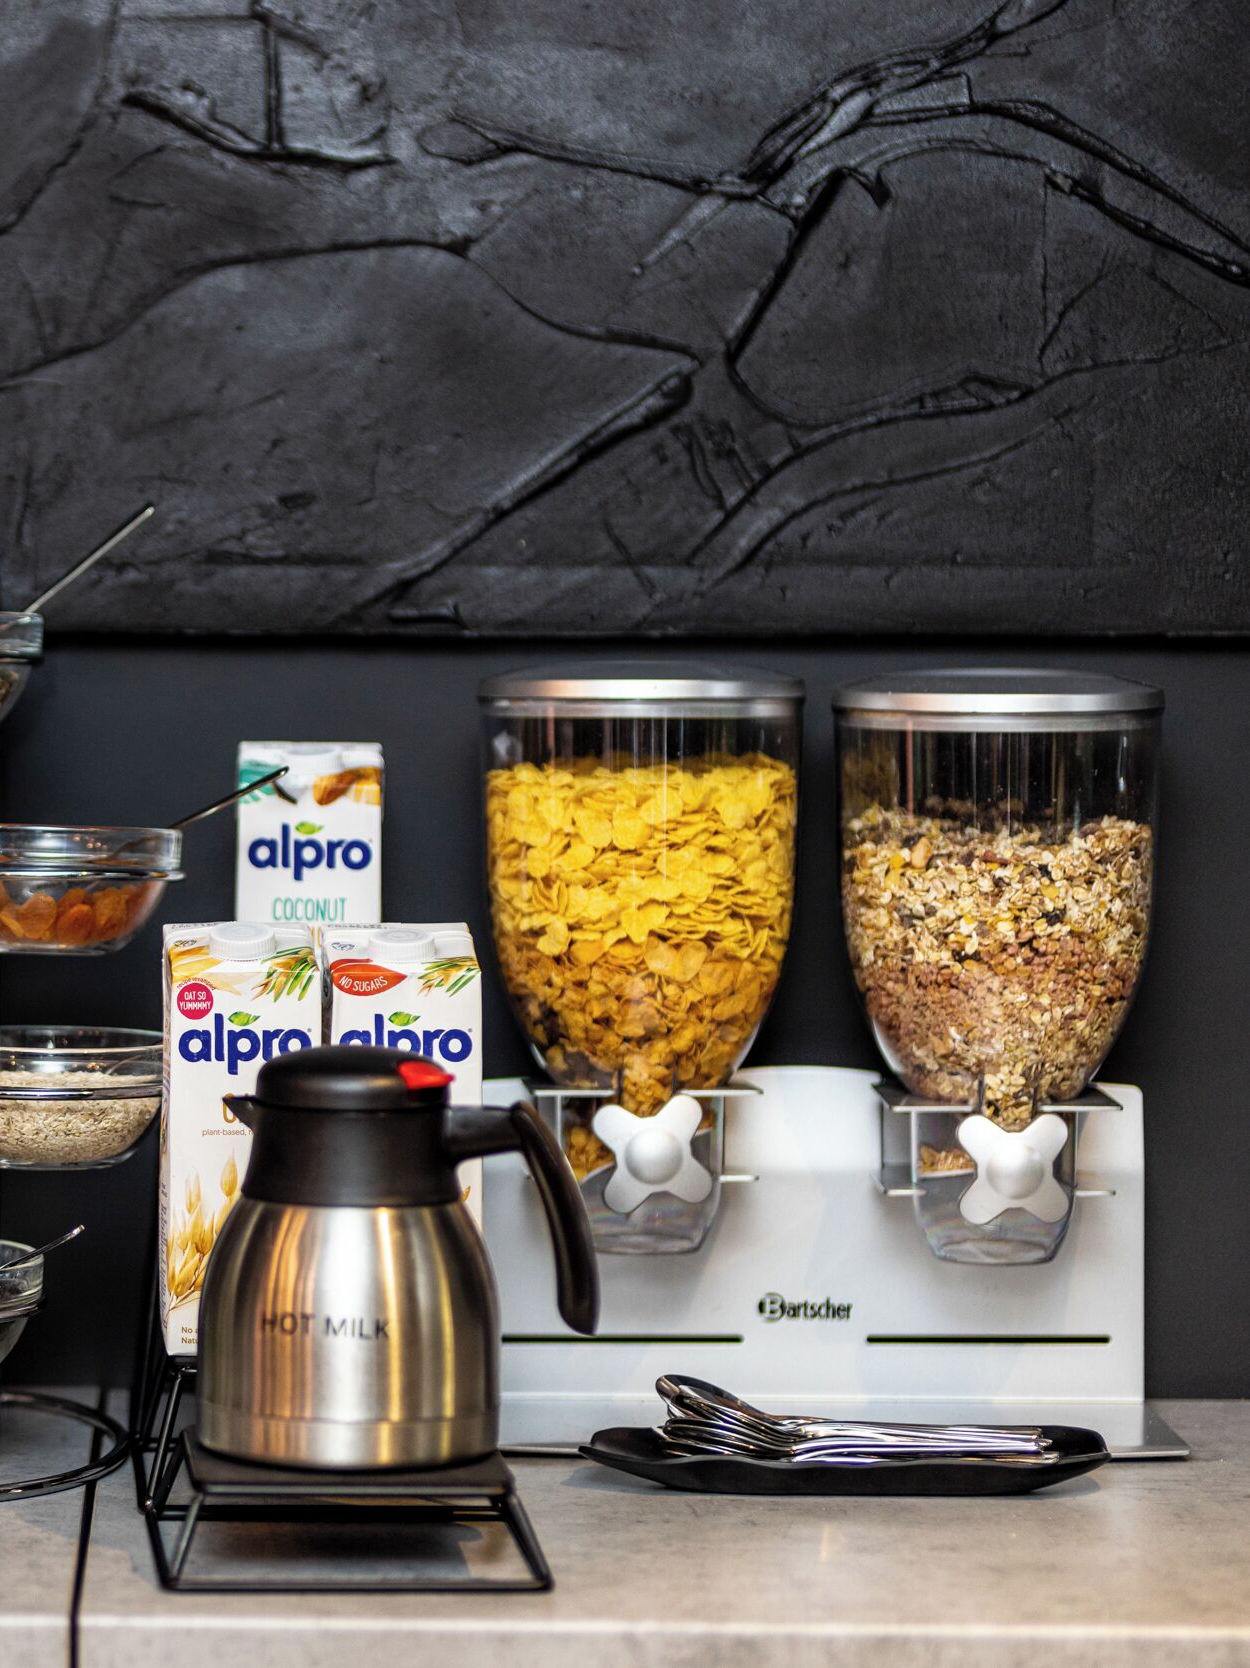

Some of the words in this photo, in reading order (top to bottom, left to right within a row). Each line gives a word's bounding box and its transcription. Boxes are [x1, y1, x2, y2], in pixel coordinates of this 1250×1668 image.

[249, 823, 372, 881] alpro
[272, 897, 348, 922] COCONUT
[184, 991, 196, 1001] OAT
[197, 991, 207, 1001] SO
[339, 975, 352, 989] NO
[352, 975, 388, 992] SUGARS
[178, 1013, 313, 1075] alpro
[202, 1128, 247, 1137] plant-based,
[757, 1292, 853, 1323] Bartscher
[181, 1326, 193, 1334] No
[261, 1311, 316, 1336] HOT
[325, 1316, 390, 1340] MILK
